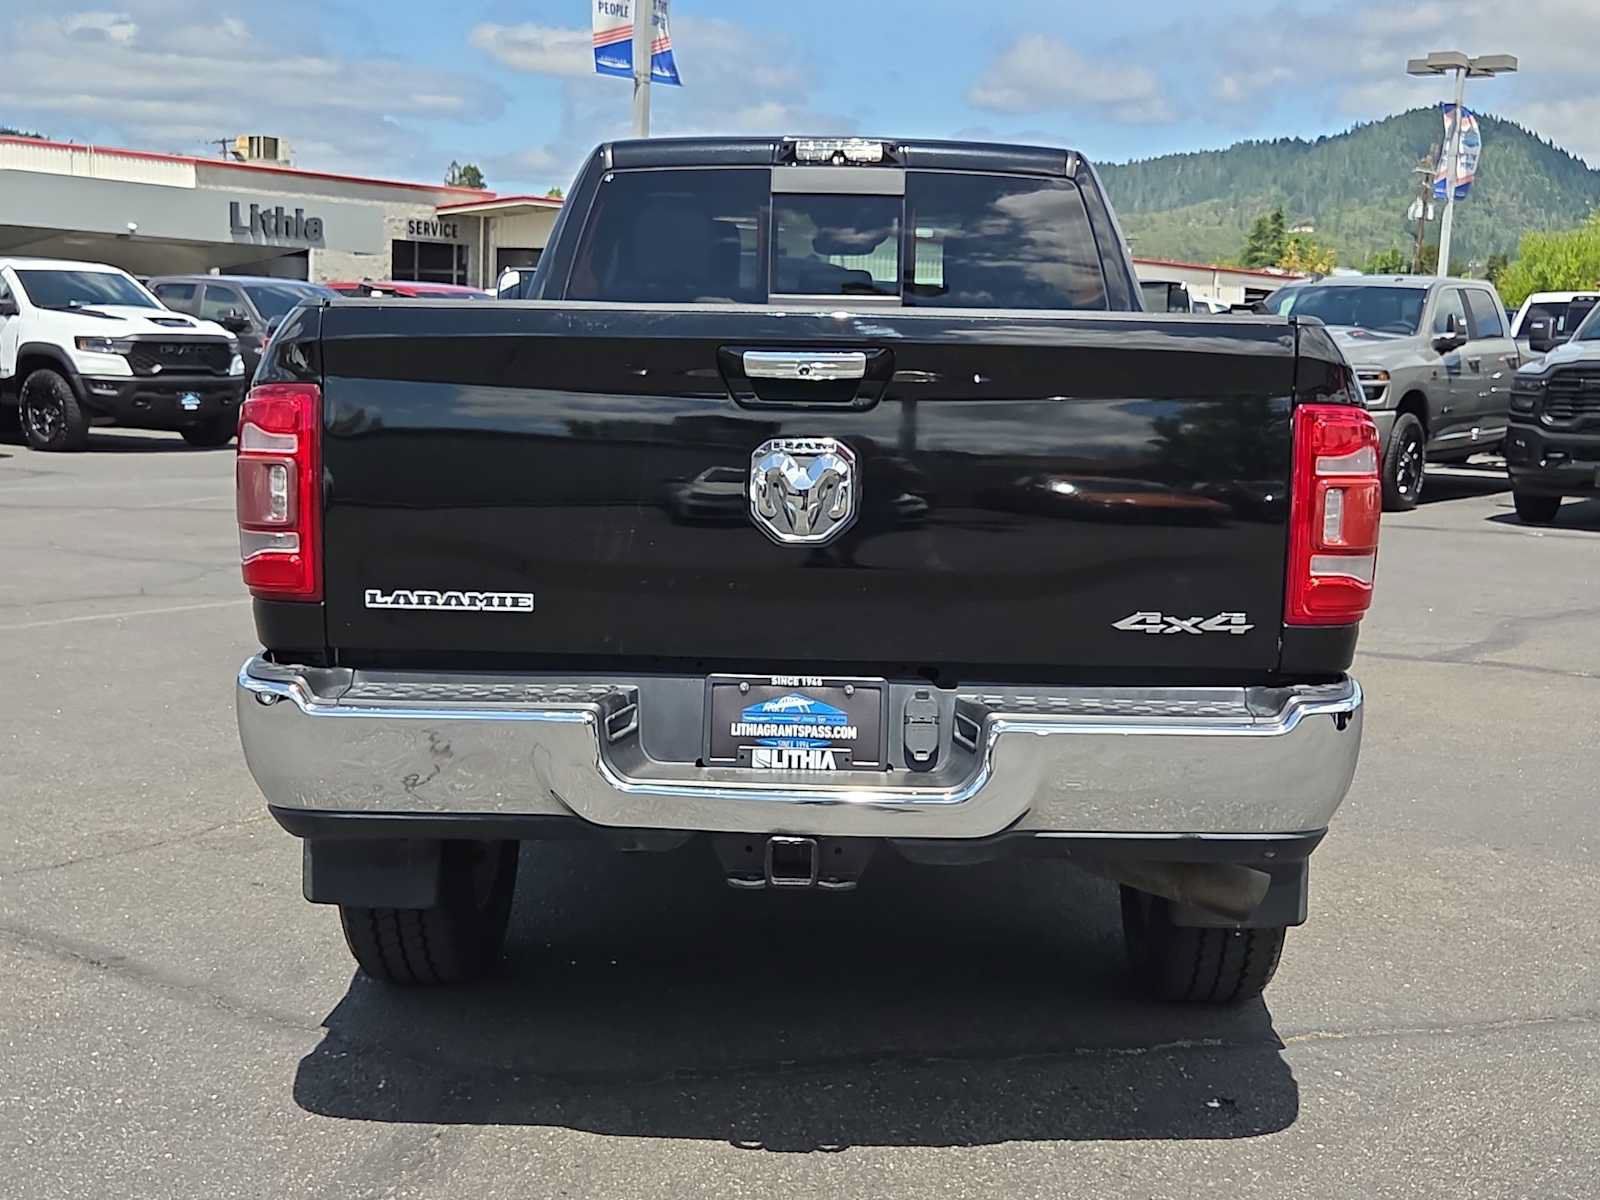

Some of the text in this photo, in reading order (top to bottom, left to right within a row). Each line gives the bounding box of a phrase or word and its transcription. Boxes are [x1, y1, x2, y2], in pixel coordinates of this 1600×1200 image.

[598, 0, 629, 18] PEOPLE
[230, 201, 323, 242] Lithia
[408, 219, 458, 239] SERVICE
[365, 589, 534, 612] LARAMIE
[771, 676, 823, 687] SINCE 1946
[731, 722, 857, 740] LITHIAGRANTSPASS.COM
[771, 749, 837, 770] LITHIA
